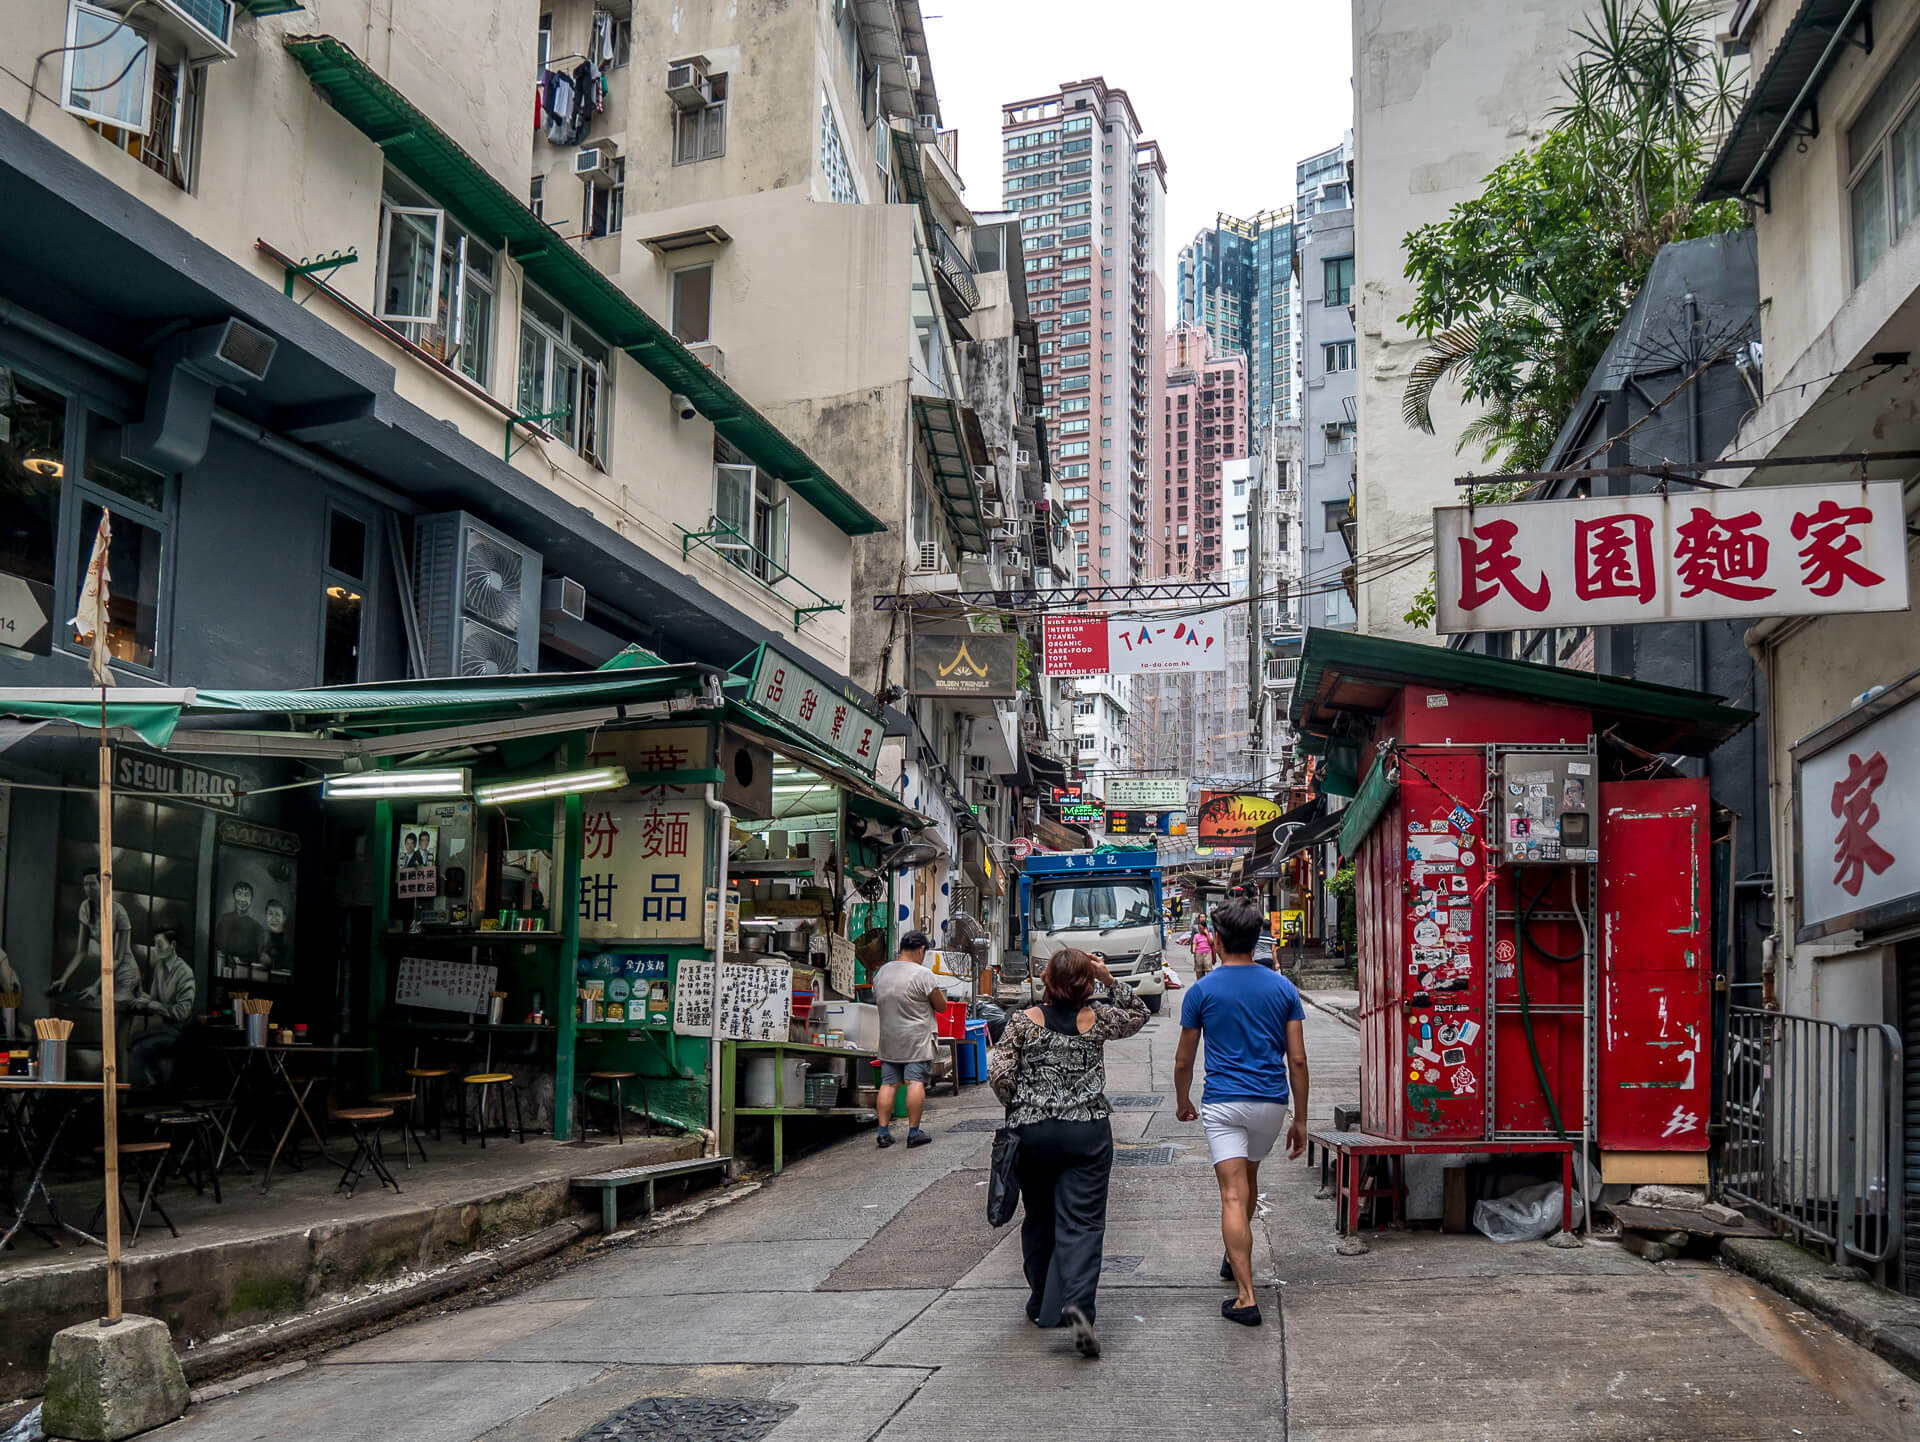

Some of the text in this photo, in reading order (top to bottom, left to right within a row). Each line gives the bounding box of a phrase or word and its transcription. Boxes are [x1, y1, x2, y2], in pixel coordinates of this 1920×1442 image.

[1457, 500, 1887, 612] 民園麵家
[120, 757, 236, 808] SEOUL BROS
[582, 808, 690, 859] 粉麵
[1204, 801, 1277, 821] Sahara
[1832, 751, 1896, 896] 家
[579, 873, 688, 922] 甜品
[625, 959, 665, 974] 全力支持
